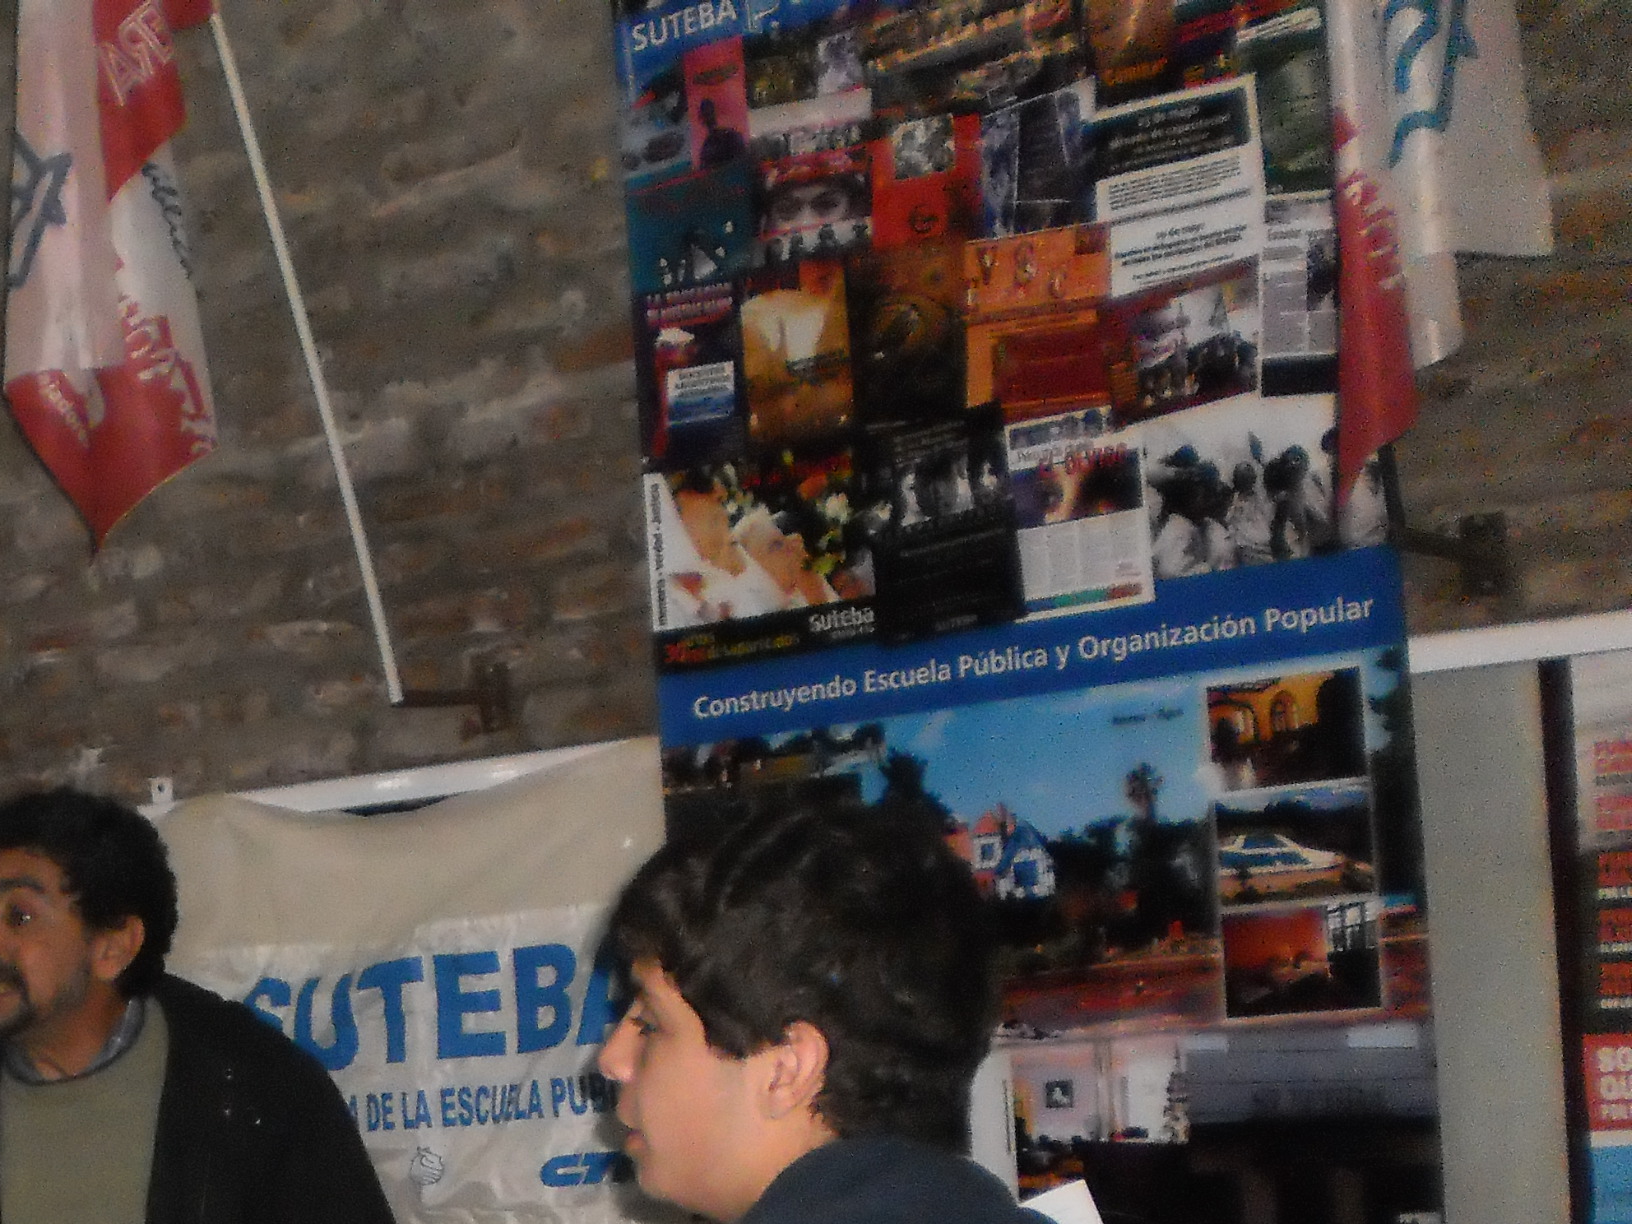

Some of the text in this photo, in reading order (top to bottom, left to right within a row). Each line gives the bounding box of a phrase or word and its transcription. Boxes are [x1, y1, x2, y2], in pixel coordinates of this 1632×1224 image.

[631, 0, 738, 52] SUTEBA
[693, 597, 1375, 721] Construyendo Escuela Pública y Organización Popular
[366, 1092, 396, 1132] DE
[401, 1089, 432, 1129] LA
[440, 1079, 545, 1128] ESCUELA
